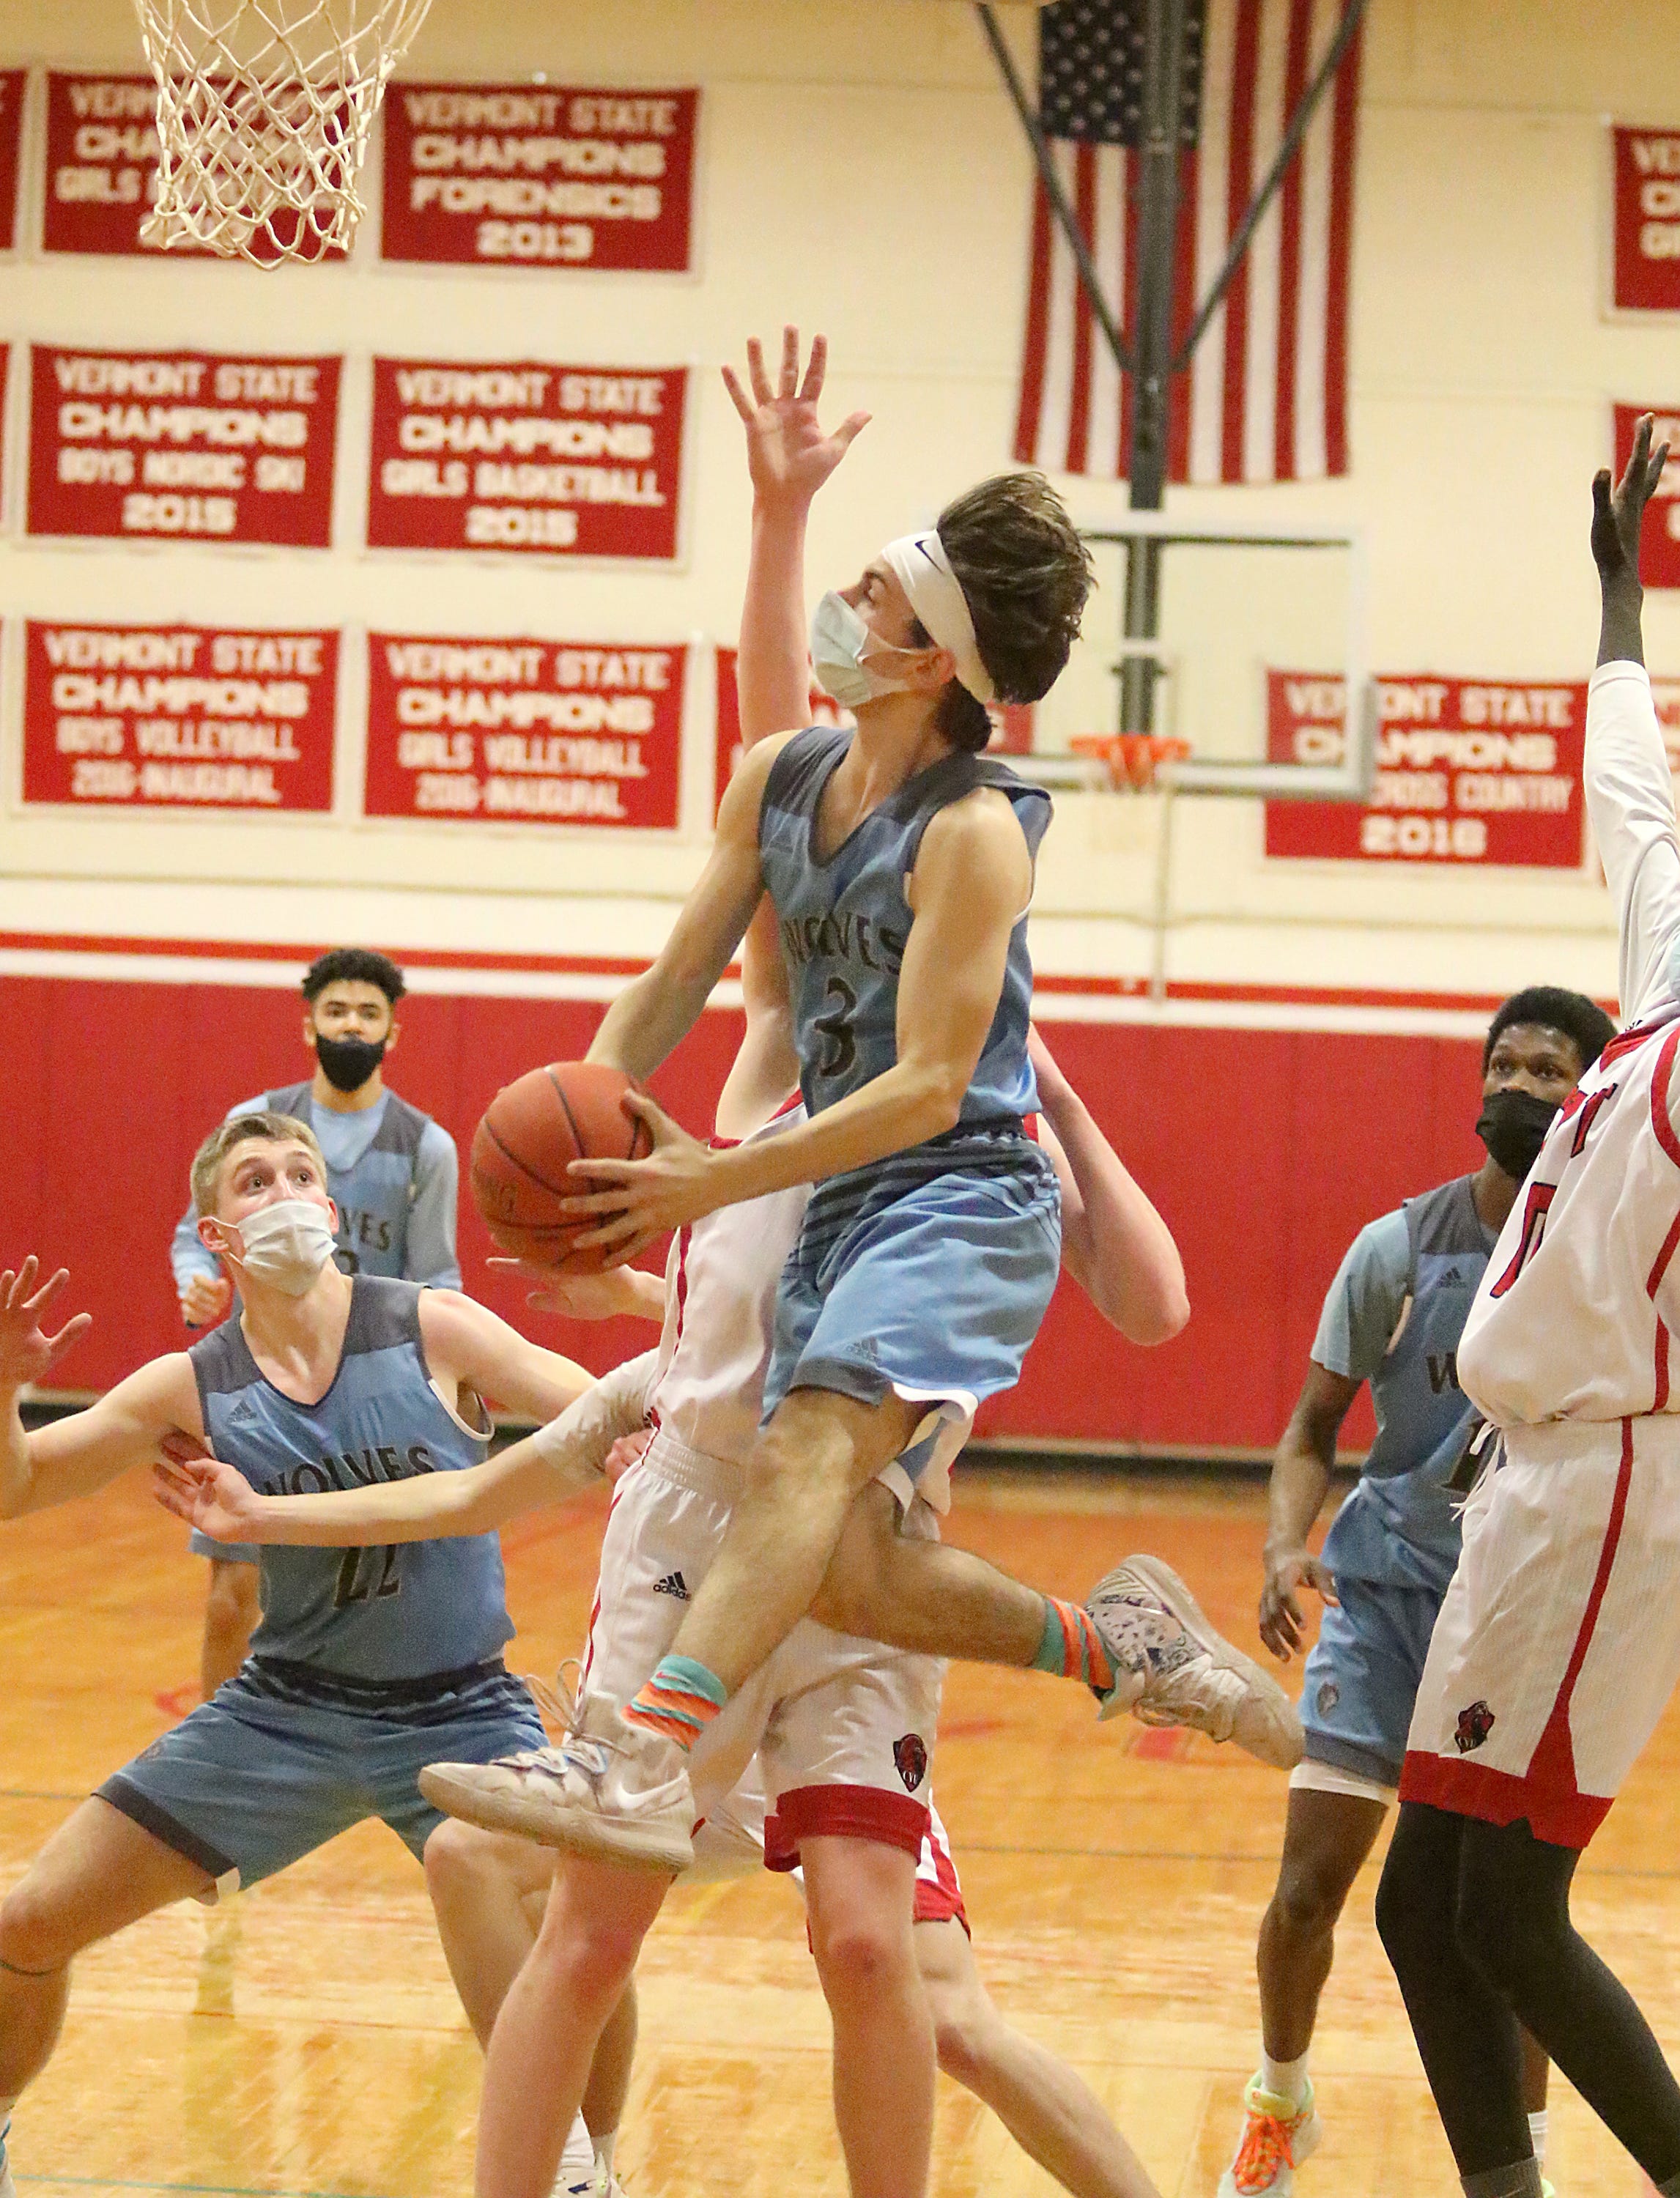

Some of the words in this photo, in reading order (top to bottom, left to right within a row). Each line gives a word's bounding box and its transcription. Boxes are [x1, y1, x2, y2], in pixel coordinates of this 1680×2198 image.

[405, 92, 564, 127] VERMONT
[569, 98, 677, 135] STATE
[412, 134, 665, 178] CHAMPIONS
[410, 176, 662, 221] FORENSICS
[476, 221, 593, 260] 2013
[55, 357, 207, 396] VERMONT
[215, 364, 320, 403] STATE
[396, 369, 551, 407] VERMONT
[559, 374, 665, 415] STATE
[59, 402, 308, 448] CHAMPIONS
[399, 415, 654, 459] CHAMPIONS
[381, 459, 468, 499] GIRLS
[474, 461, 667, 508] BASKETBALL
[44, 629, 200, 670] VERMONT
[212, 636, 324, 676] STATE
[386, 643, 547, 685] VERMONT
[555, 650, 672, 691] STATE
[52, 673, 309, 718] CHAMPIONS
[396, 687, 655, 733] CHAMPIONS
[1284, 680, 1448, 720] VERONT
[1459, 687, 1573, 728] STATE
[134, 719, 300, 761] VOLLEYBALL
[484, 734, 648, 777] VOLLEYBALL
[1295, 724, 1558, 770] CMPIONS
[814, 976, 856, 1078] 3
